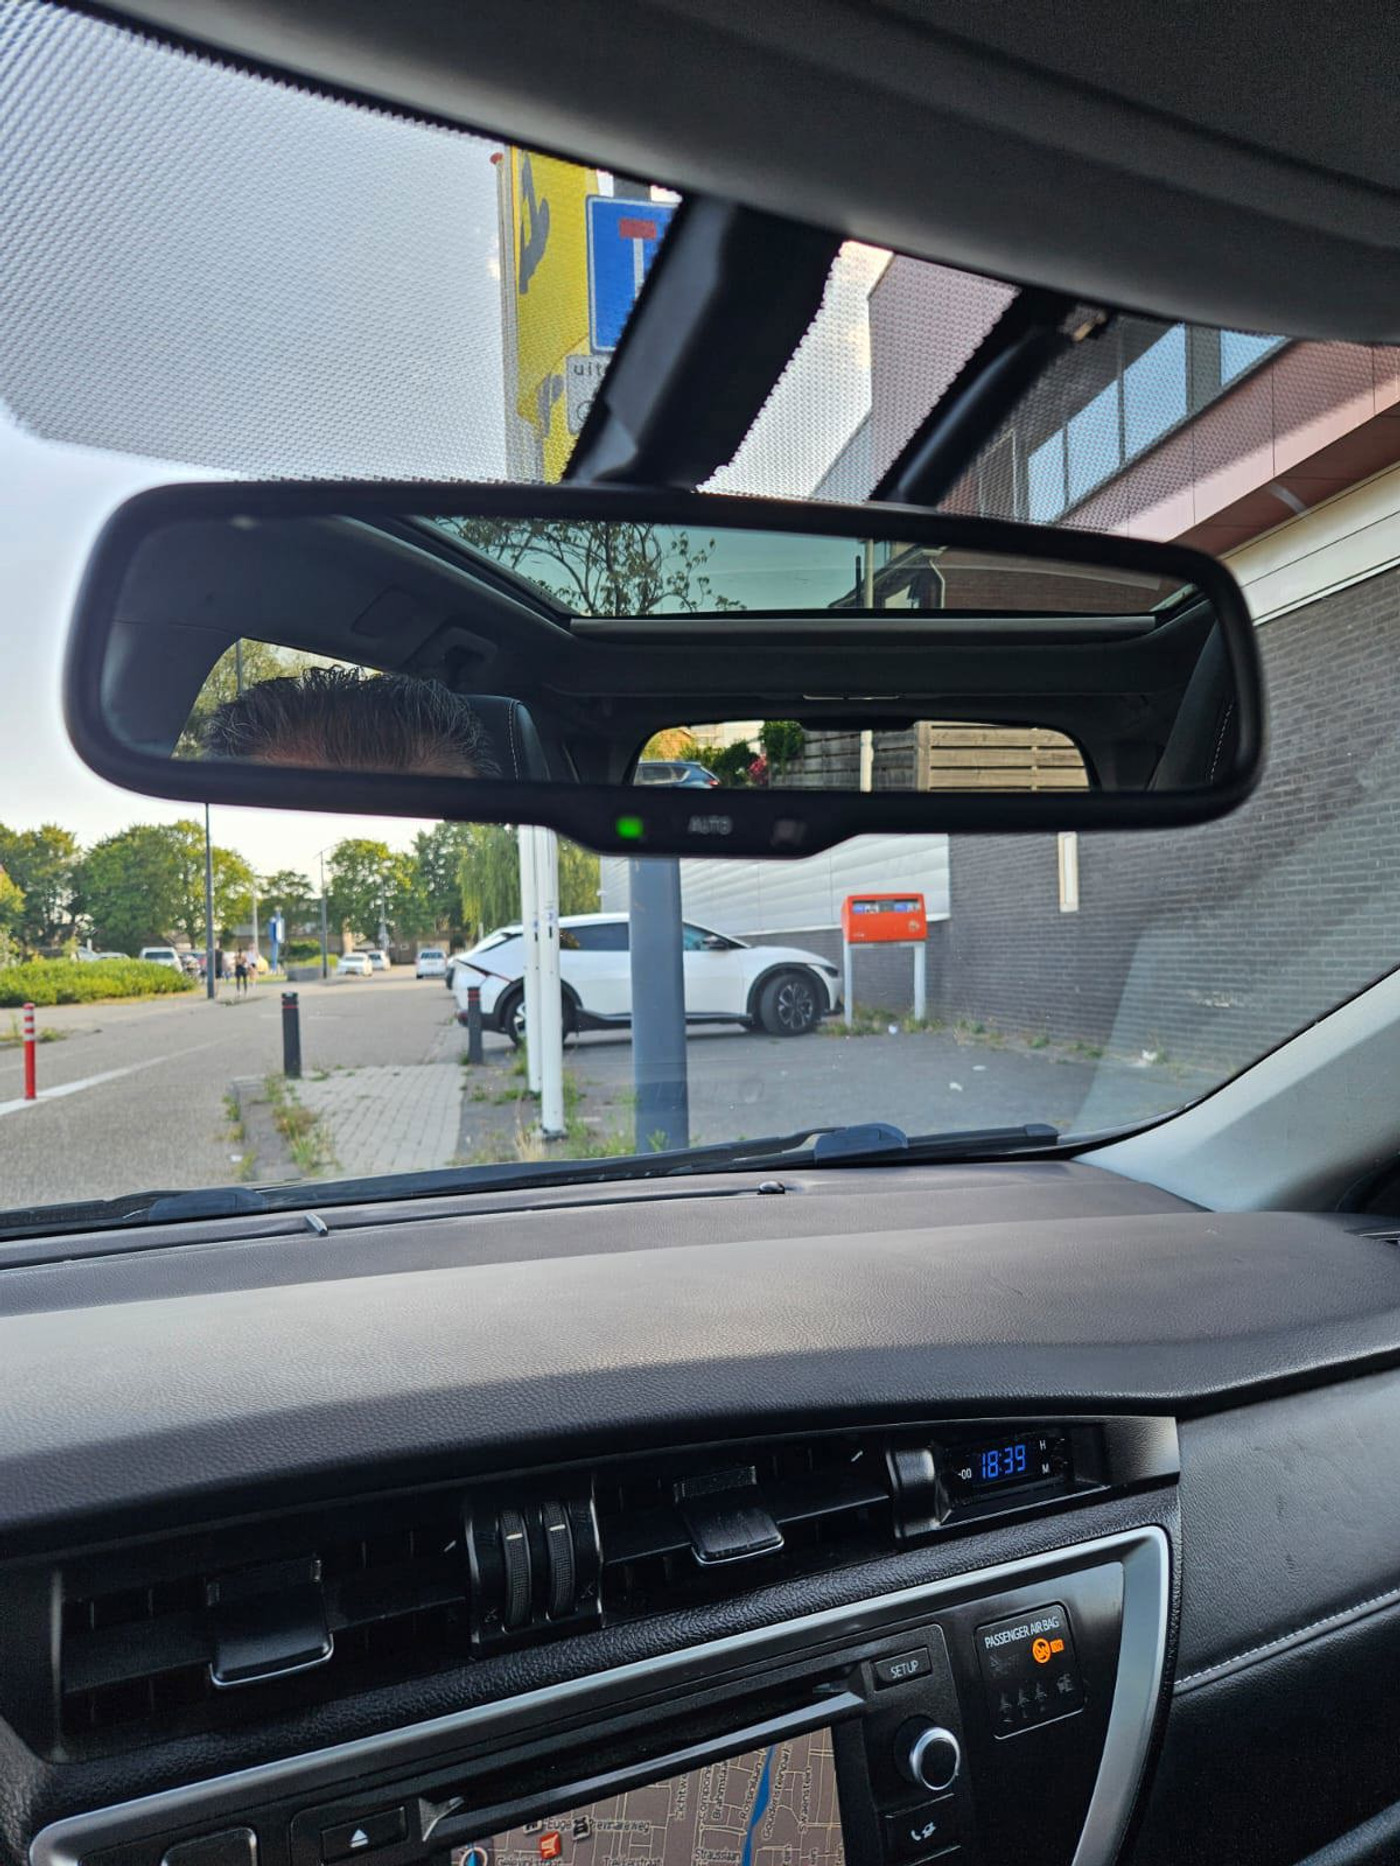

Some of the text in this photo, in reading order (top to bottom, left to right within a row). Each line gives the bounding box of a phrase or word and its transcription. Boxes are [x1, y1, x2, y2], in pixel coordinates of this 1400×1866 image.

[688, 815, 733, 835] AUTO
[1039, 1439, 1047, 1451] H
[1041, 1463, 1050, 1474] M
[984, 1624, 1031, 1648] PASSENGER
